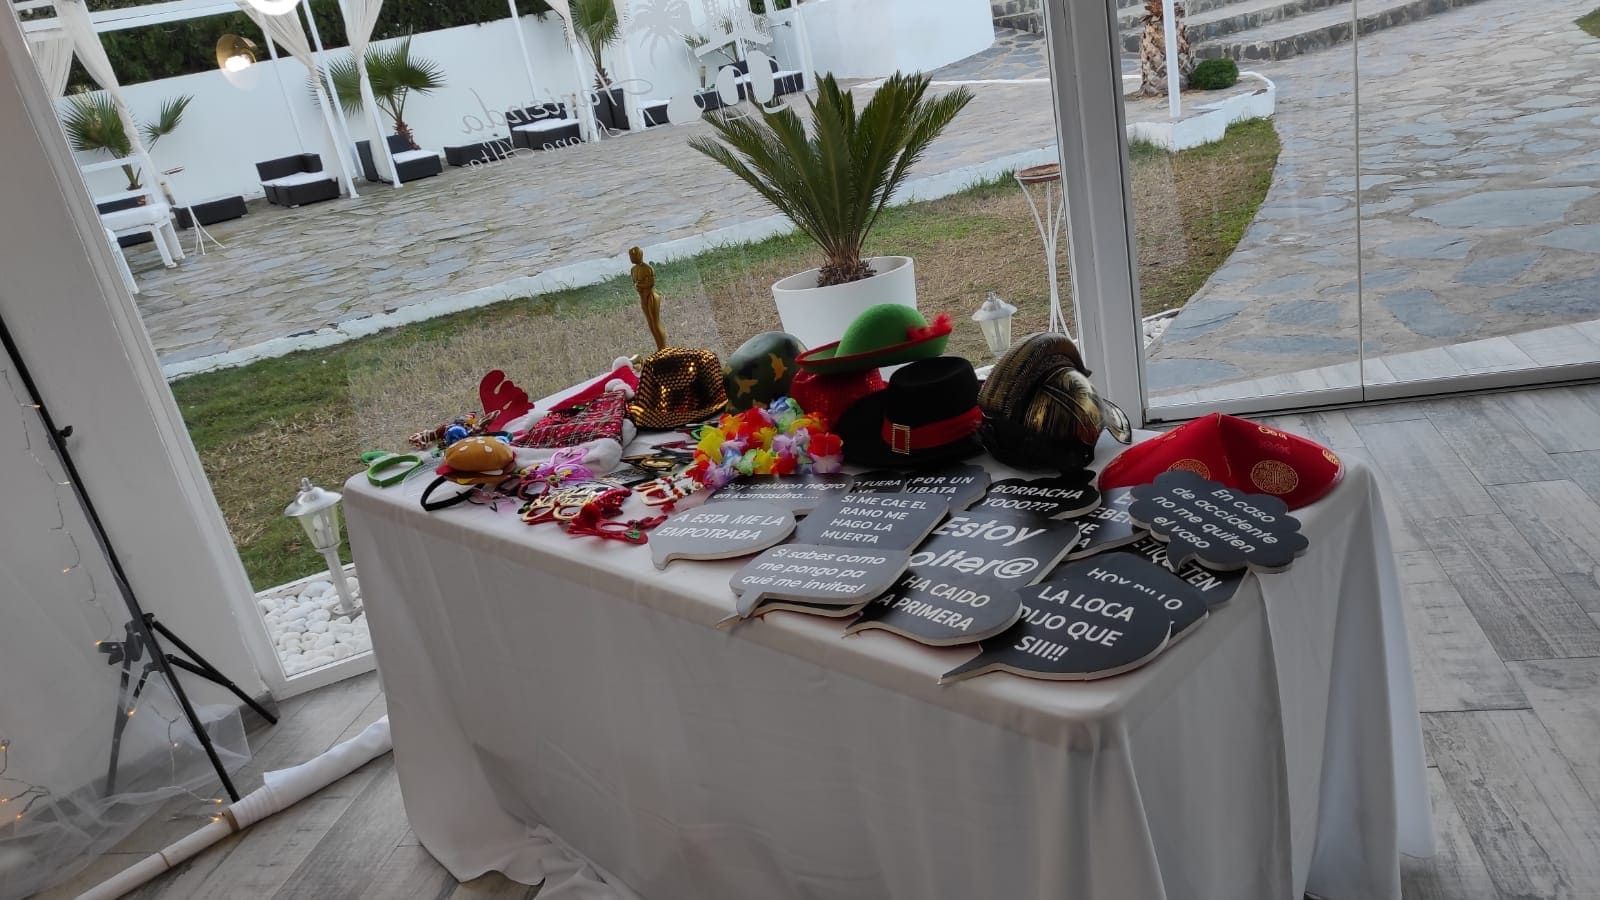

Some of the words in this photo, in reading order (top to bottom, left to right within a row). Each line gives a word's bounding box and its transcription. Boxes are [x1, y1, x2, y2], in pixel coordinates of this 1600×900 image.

[804, 483, 847, 491] negro
[949, 476, 975, 485] UN
[905, 486, 958, 495] UBATA
[990, 484, 1084, 500] BORRACHA
[841, 495, 857, 503] SI
[856, 496, 880, 505] ME
[880, 498, 909, 508] CAE
[910, 501, 927, 510] EL
[981, 497, 1059, 512] YOOO???
[1210, 489, 1234, 502] En
[1233, 501, 1276, 523] caso
[690, 513, 730, 524] ESTA
[730, 514, 762, 525] ME
[761, 515, 786, 526] LA
[839, 506, 884, 518] RAMO
[884, 511, 909, 521] ME
[1172, 487, 1196, 500] de
[1194, 499, 1279, 544] accidente
[656, 526, 763, 540] EMPOTRABA
[830, 518, 873, 529] HAGO
[873, 522, 894, 532] LA
[931, 516, 1047, 547] Estoy
[1152, 496, 1176, 509] no
[1173, 507, 1203, 524] me
[1201, 523, 1256, 554] quiten
[1153, 516, 1177, 527] el
[1170, 525, 1211, 549] vaso
[820, 530, 880, 544] MUERTA
[787, 550, 836, 561] sabes
[836, 554, 886, 565] como
[908, 549, 1039, 579] olter@
[756, 561, 784, 571] me
[782, 563, 839, 577] pongo
[835, 569, 868, 579] pa
[772, 578, 801, 588] me
[801, 578, 867, 594] invitas!
[901, 575, 932, 592] HA
[929, 583, 991, 608] CAIDO
[1037, 585, 1070, 605] LA
[1070, 594, 1135, 622] LOCA
[891, 597, 974, 632] PRIMERA
[1067, 621, 1124, 647] QUE
